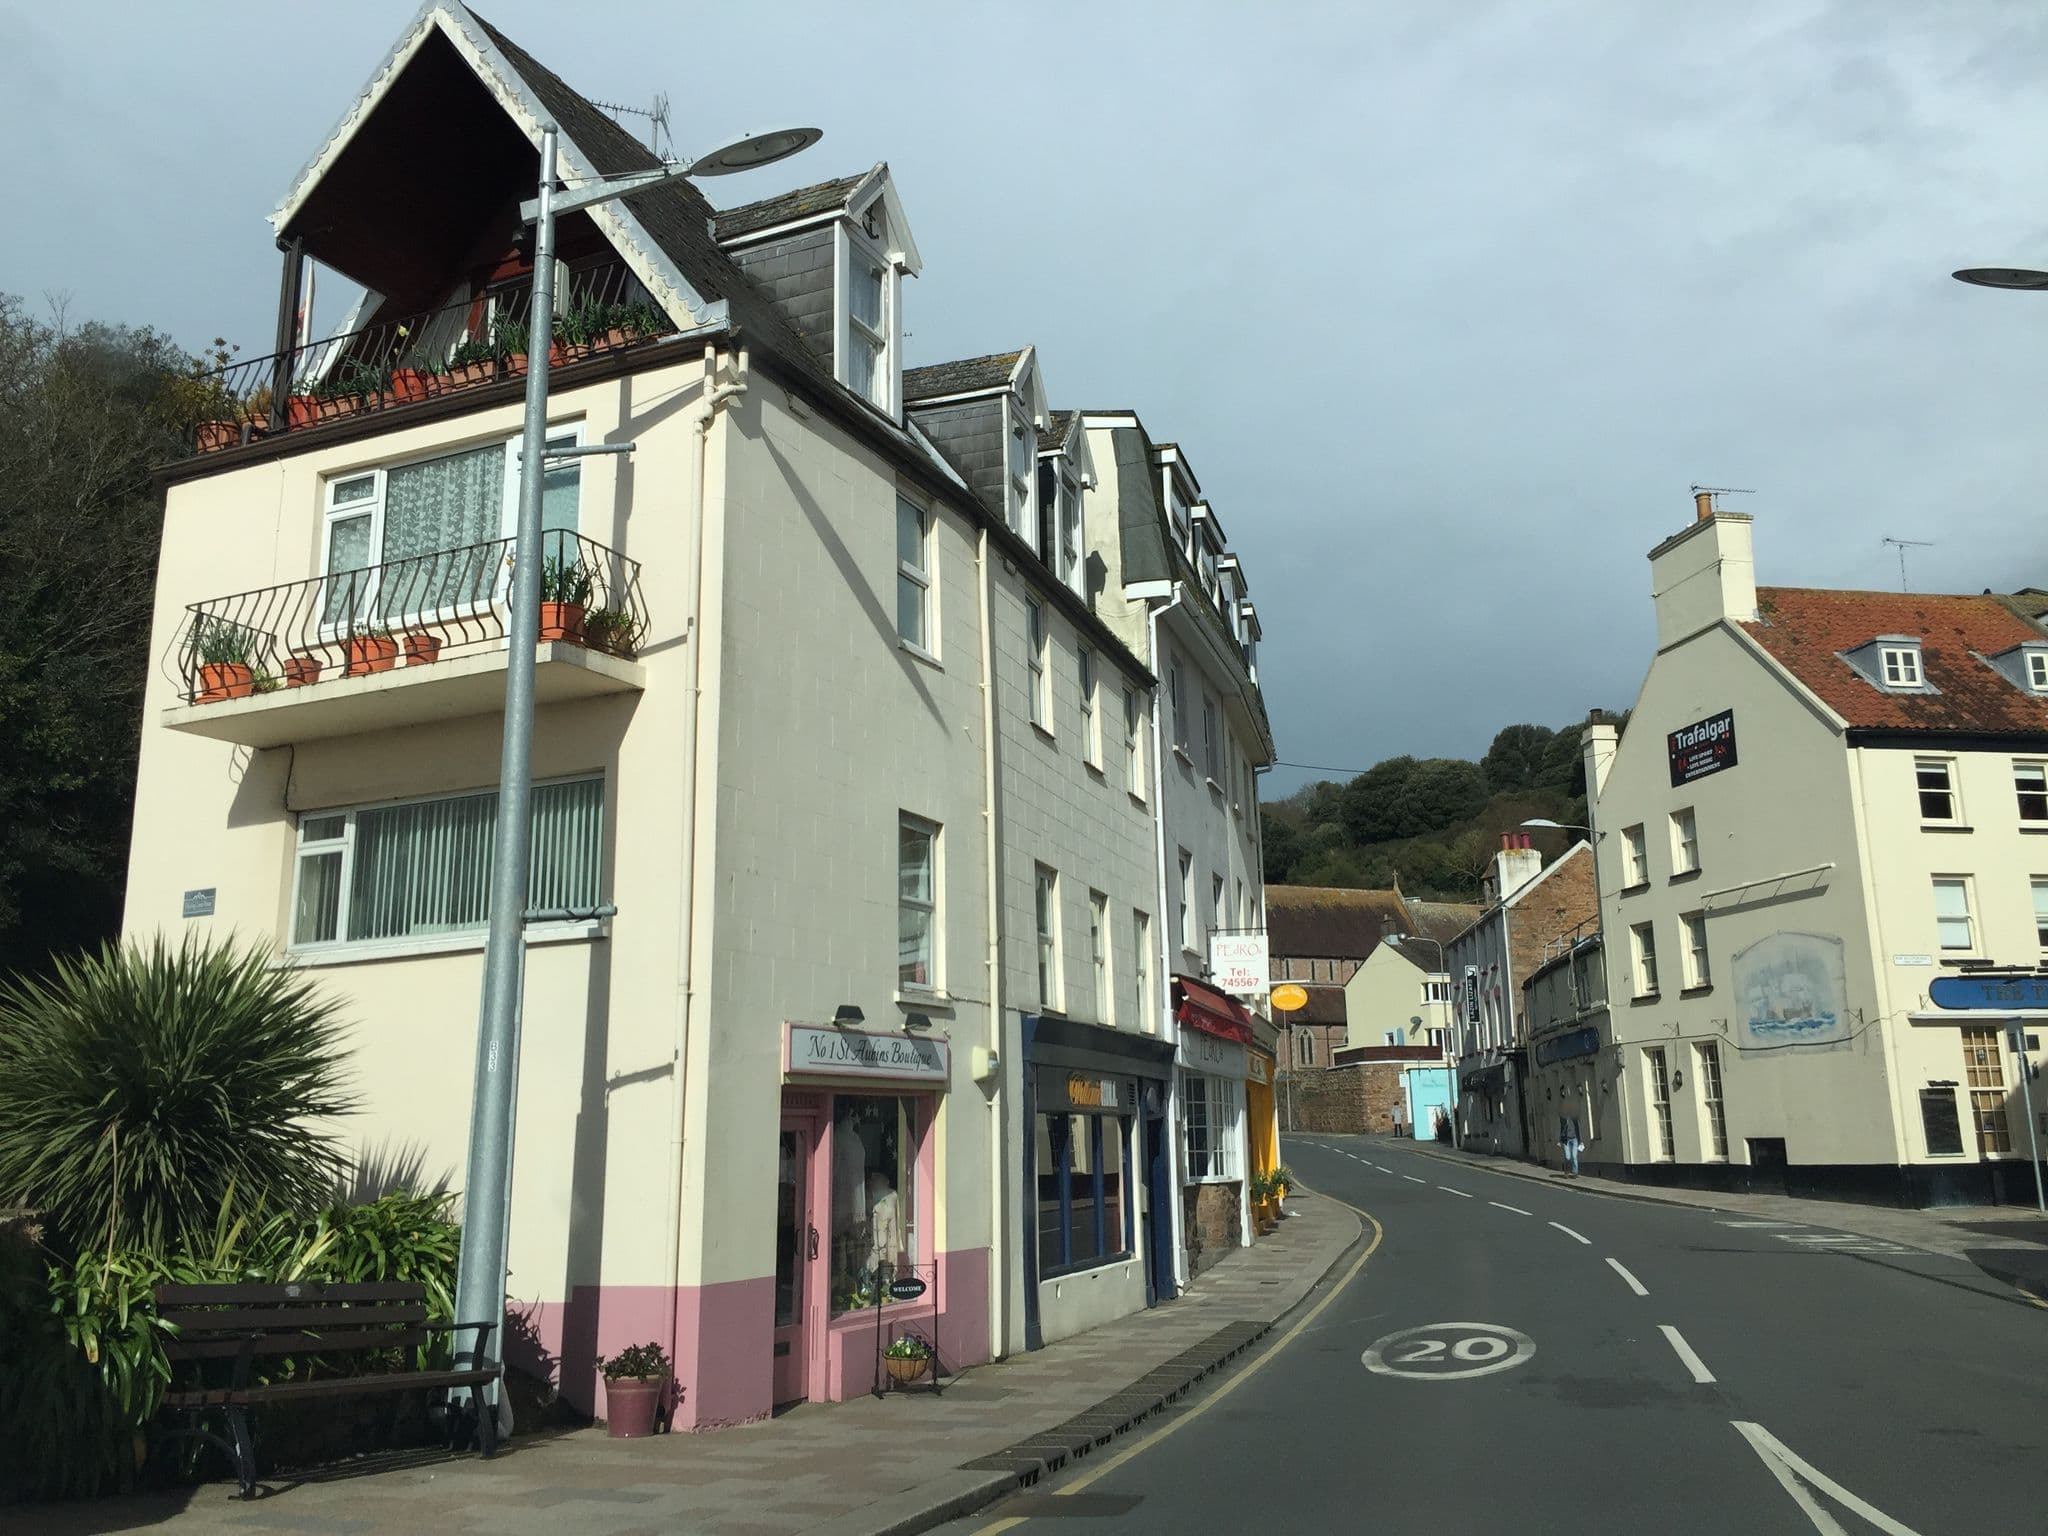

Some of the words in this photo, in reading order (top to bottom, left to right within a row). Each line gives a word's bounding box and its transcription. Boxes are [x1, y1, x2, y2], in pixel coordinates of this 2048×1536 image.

[1675, 718, 1730, 750] Trafalgar
[1222, 977, 1259, 987] 745567
[837, 1036, 850, 1060] St
[852, 1039, 889, 1062] Aubins
[891, 1041, 932, 1071] Boutique
[1395, 1337, 1508, 1362] 20
